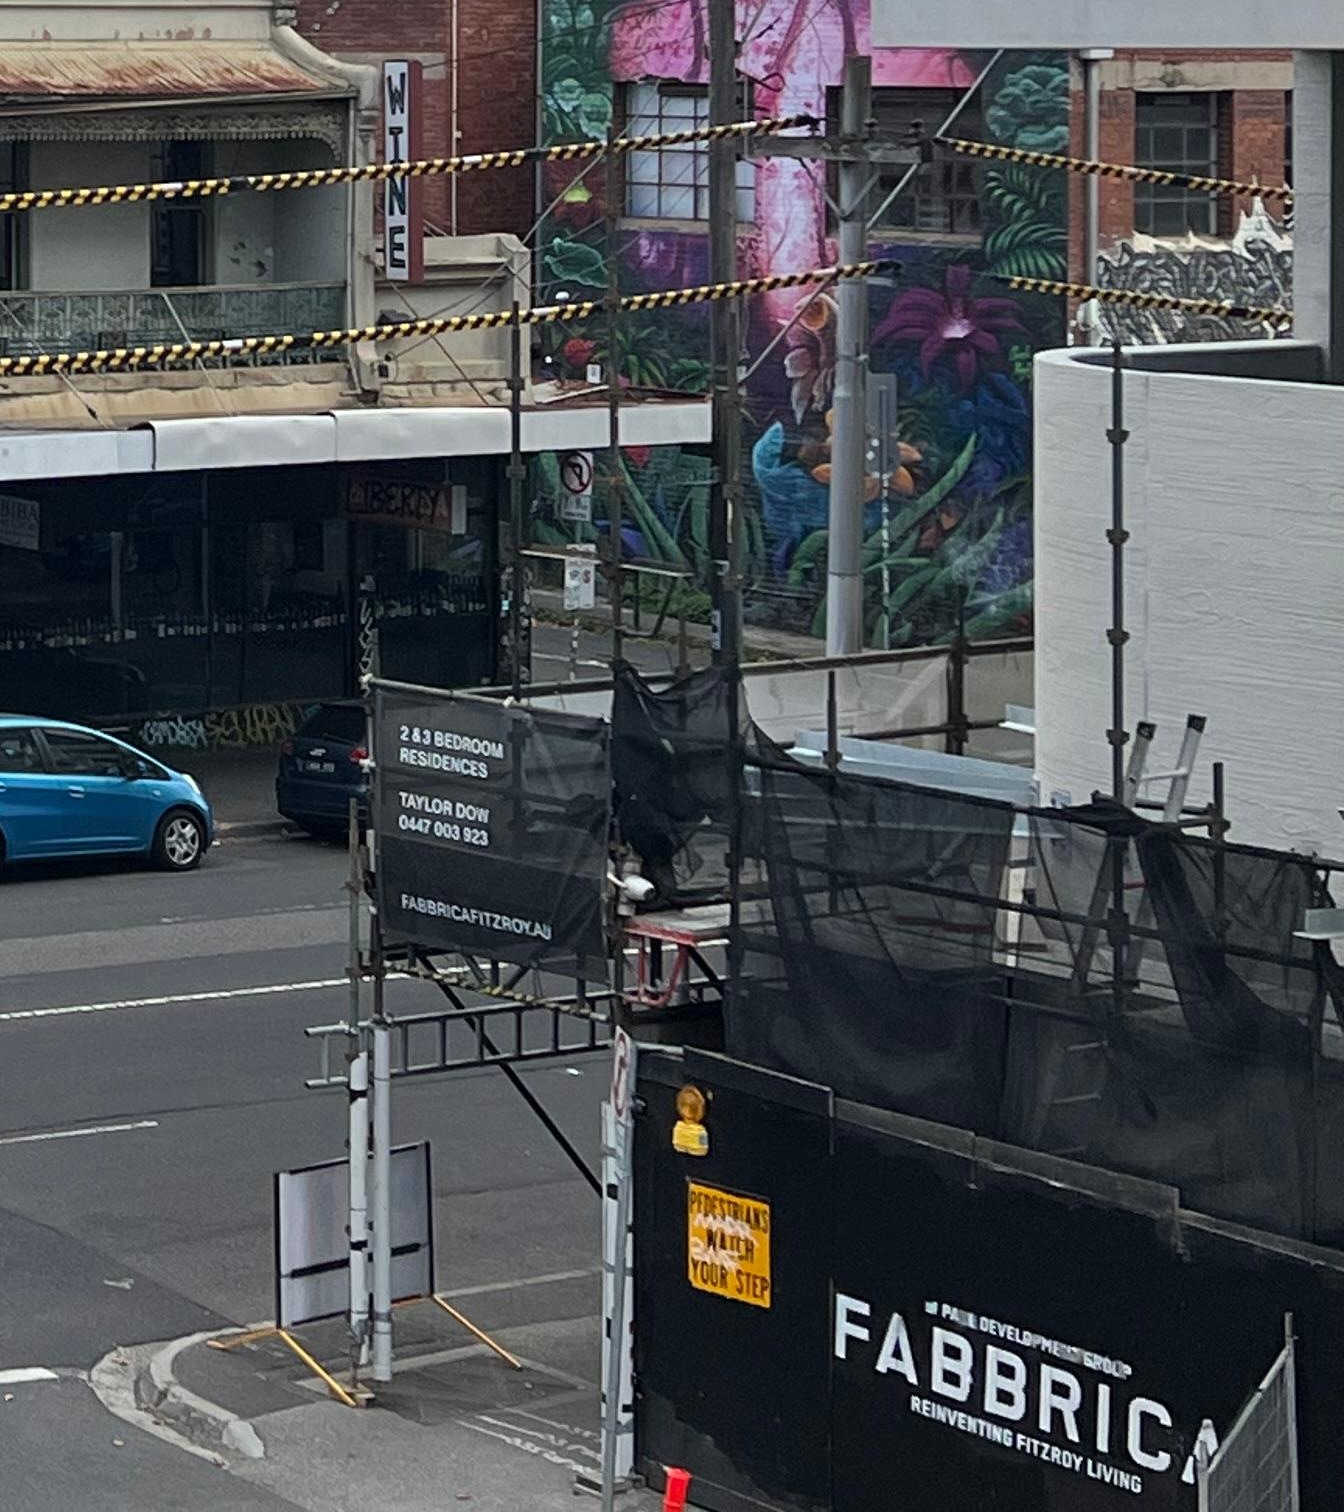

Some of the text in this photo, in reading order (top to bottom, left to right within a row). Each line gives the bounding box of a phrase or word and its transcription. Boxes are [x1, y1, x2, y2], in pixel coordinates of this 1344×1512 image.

[386, 72, 407, 269] WINE
[399, 747, 489, 779] RESIDENCES
[434, 730, 504, 760] BEDROOM
[398, 791, 490, 824] TAYLOR DOW
[398, 814, 489, 847] 0447 003 923
[401, 893, 553, 940] FABBRICAFITZROY.AU
[690, 1190, 769, 1235] PEDESTRIANS
[706, 1228, 755, 1264] WATCH
[690, 1257, 770, 1300] YOUR STEP
[1083, 1351, 1133, 1380] GROUP
[910, 1395, 1143, 1494] REINVENTING FITZROY LIVING
